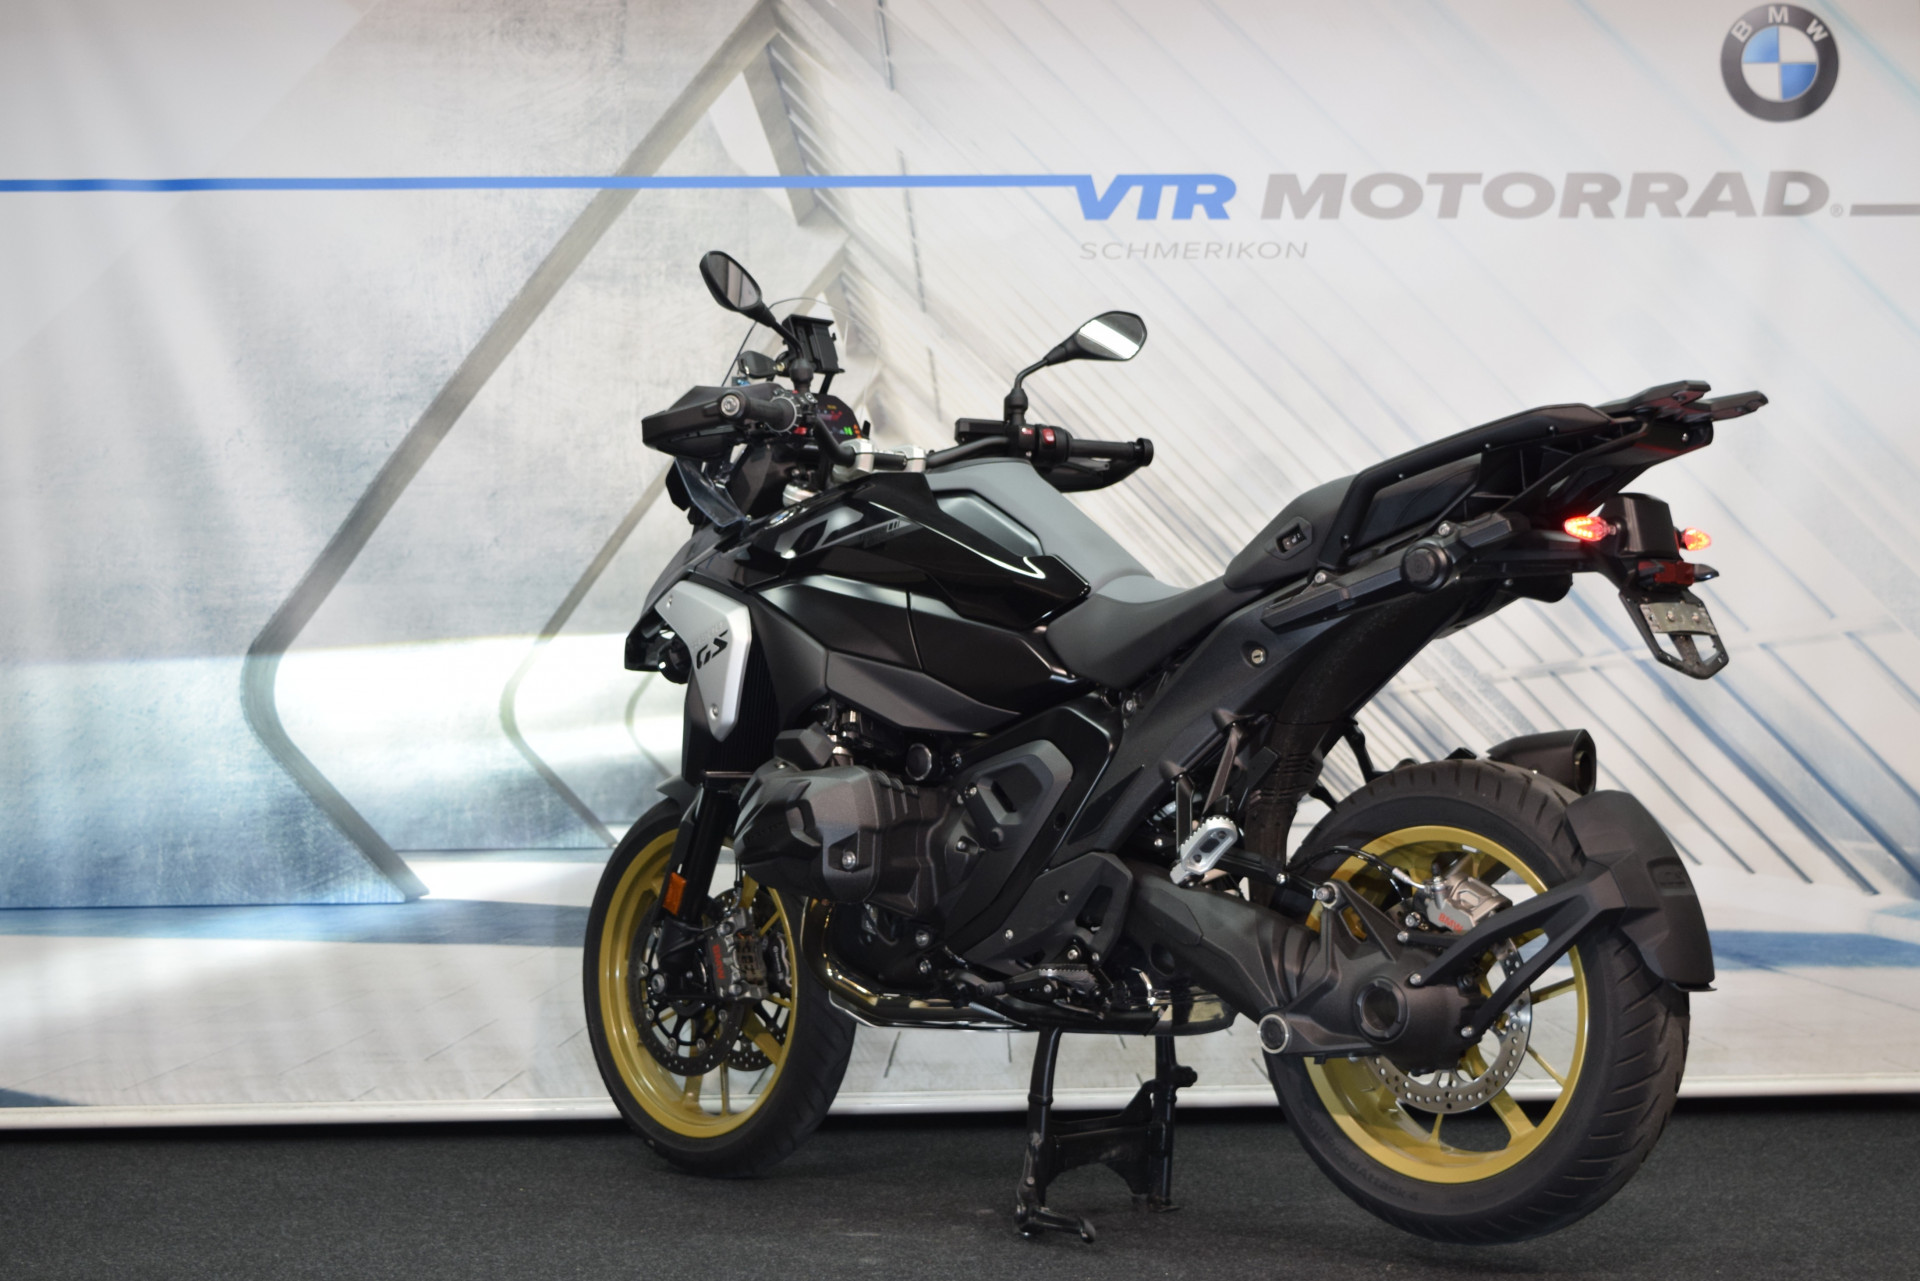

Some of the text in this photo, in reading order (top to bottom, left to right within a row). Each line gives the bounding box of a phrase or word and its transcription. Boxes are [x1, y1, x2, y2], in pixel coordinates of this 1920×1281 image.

[1731, 6, 1828, 43] BMW
[1074, 173, 1237, 221] VTR
[1079, 241, 1308, 260] SCHMERIKON
[696, 628, 730, 670] GS
[1438, 912, 1464, 934] BMW
[712, 943, 726, 980] BMW
